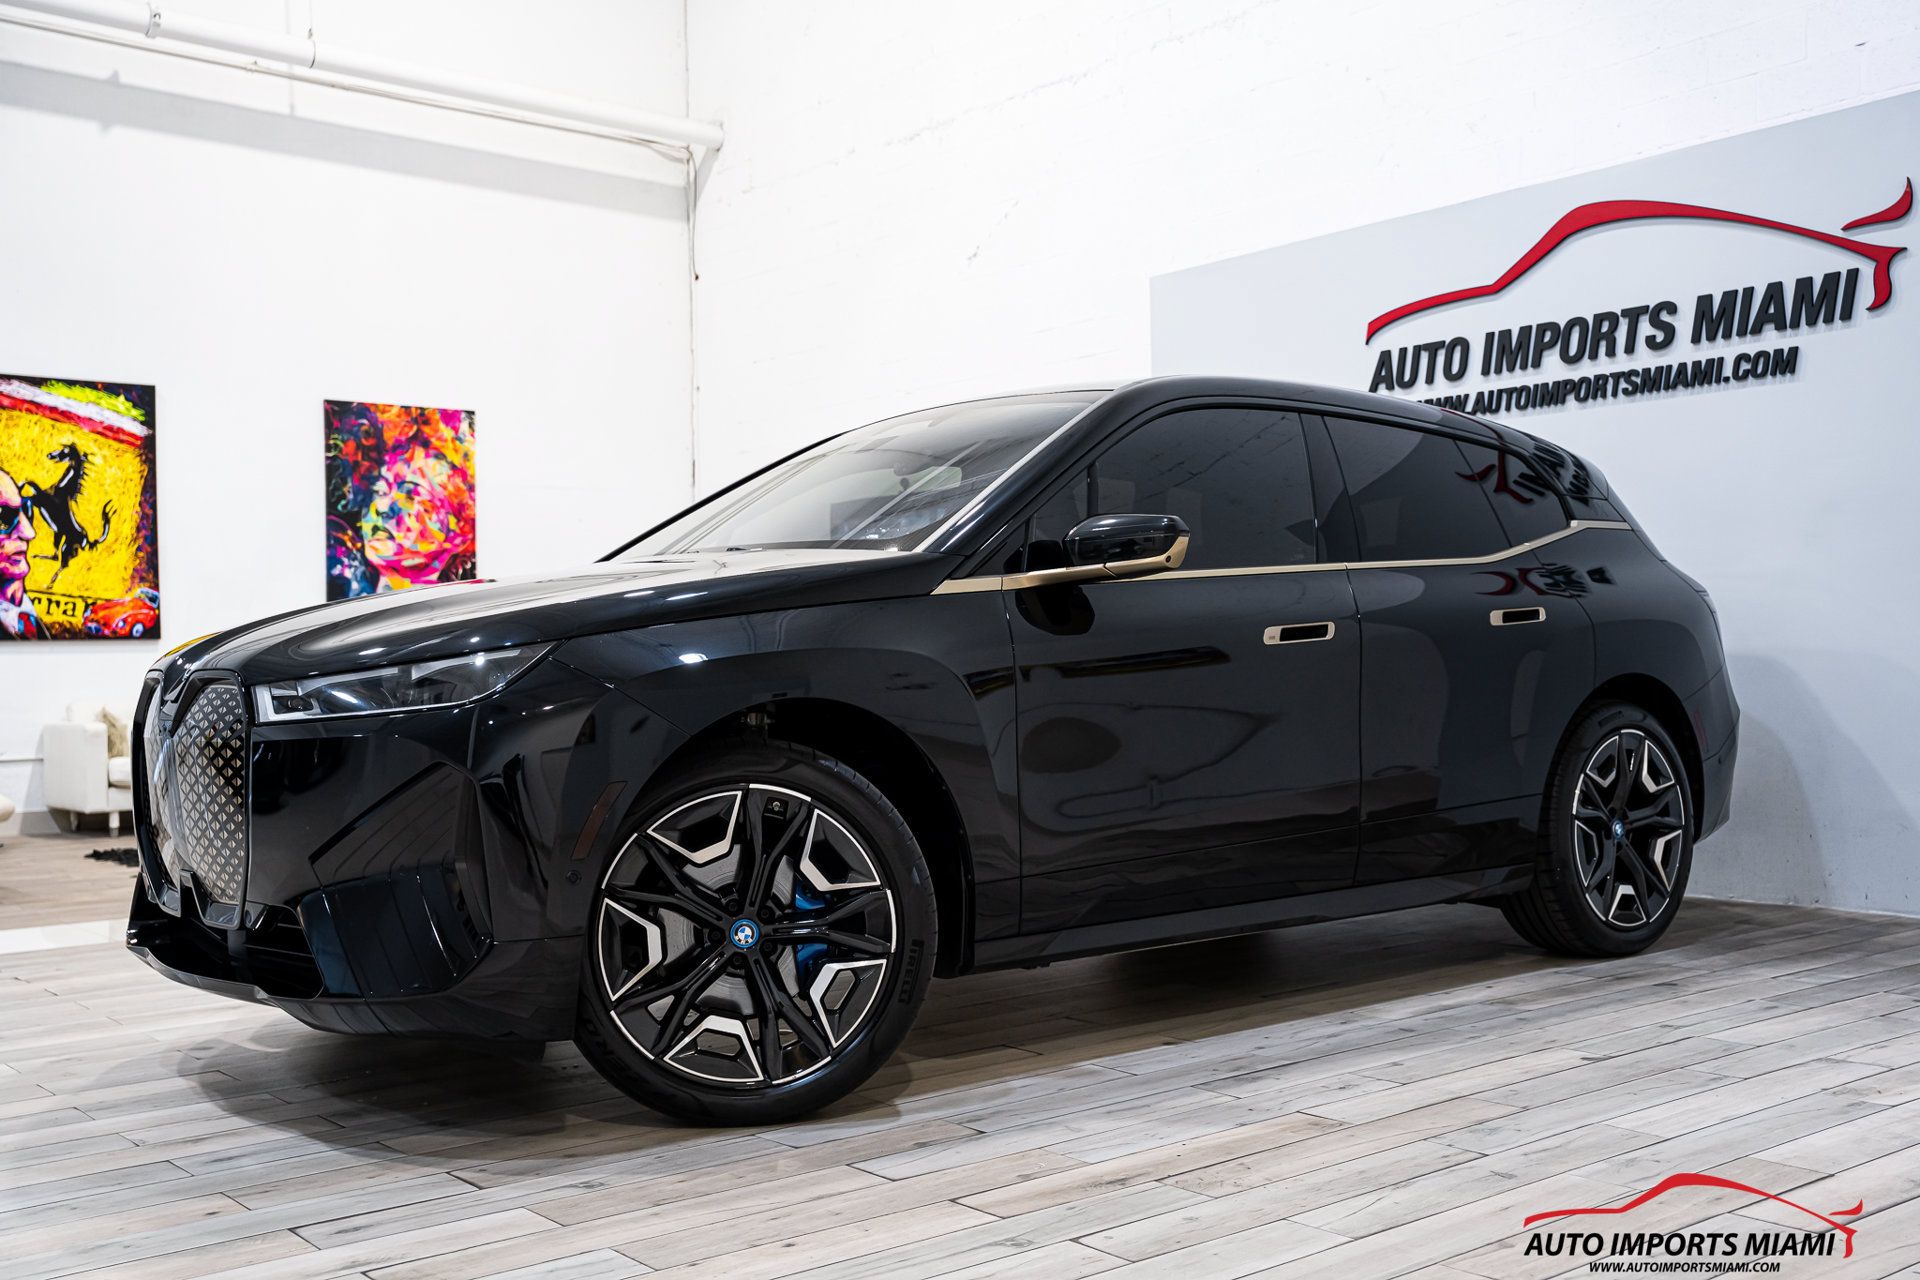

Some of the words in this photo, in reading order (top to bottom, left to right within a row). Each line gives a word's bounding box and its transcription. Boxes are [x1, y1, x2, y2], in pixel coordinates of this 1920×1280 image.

[1368, 336, 1470, 392] AUTO
[1481, 300, 1678, 377] IMPORTS
[1690, 267, 1860, 344] MIAMI
